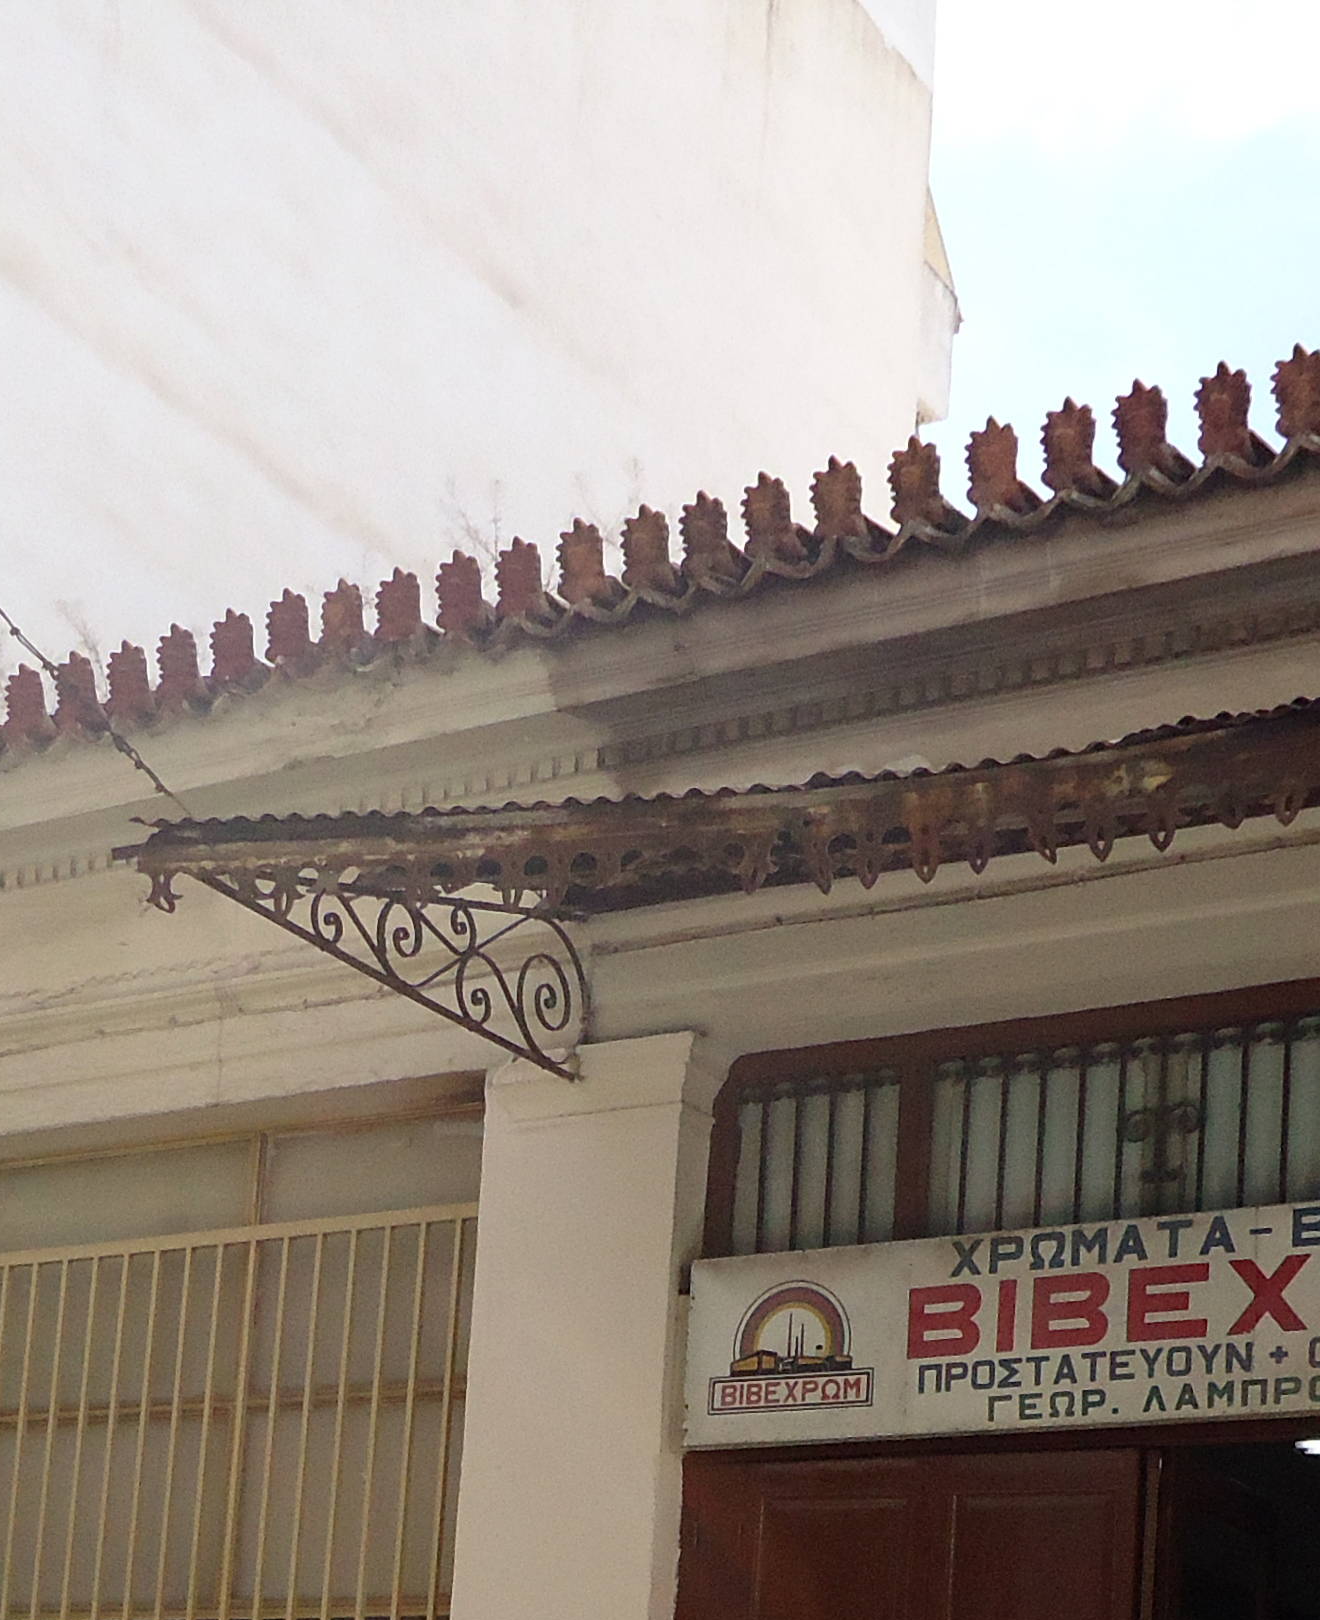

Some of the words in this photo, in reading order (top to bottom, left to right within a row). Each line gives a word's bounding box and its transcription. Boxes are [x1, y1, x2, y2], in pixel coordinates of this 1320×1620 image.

[950, 1215, 1235, 1278] ΧΡΩΜΑΤΑ
[917, 1341, 1255, 1395] ΠΡΟΣΤΑΤΕΥΟΥΝ
[720, 1377, 863, 1407] ΒΙΒΕΧΡΩΜ
[986, 1388, 1120, 1422] ΓΕΩΡ.
